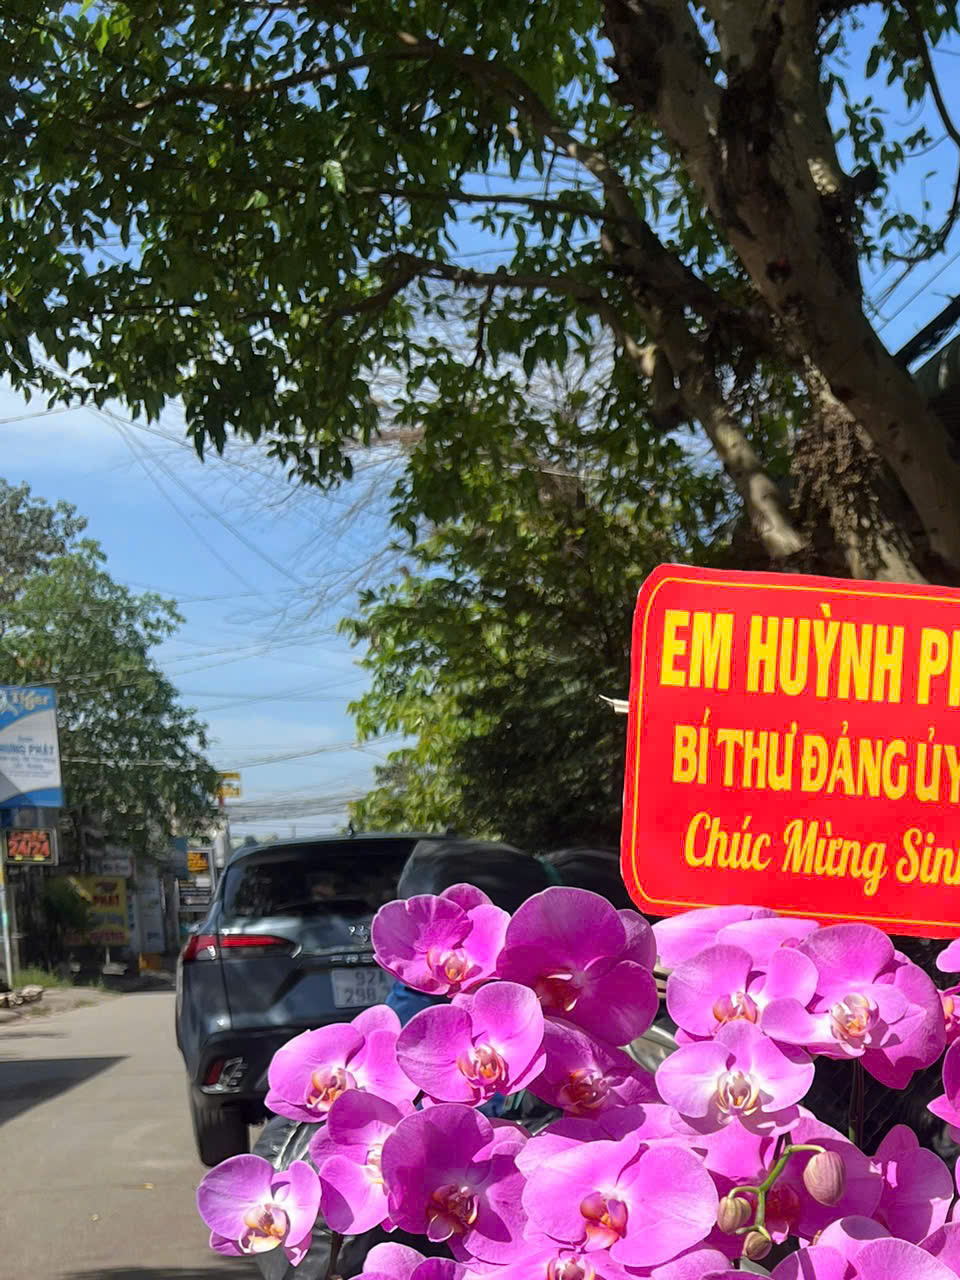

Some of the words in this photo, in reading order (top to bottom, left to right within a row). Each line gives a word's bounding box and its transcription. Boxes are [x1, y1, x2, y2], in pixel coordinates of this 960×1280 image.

[660, 609, 735, 690] EM
[746, 602, 905, 703] HUỲNH
[672, 707, 711, 784] BÍ
[716, 720, 798, 791] THƯ
[800, 720, 909, 800] ĐẢNG
[684, 811, 773, 871] Chúc
[781, 818, 889, 896] Mừng
